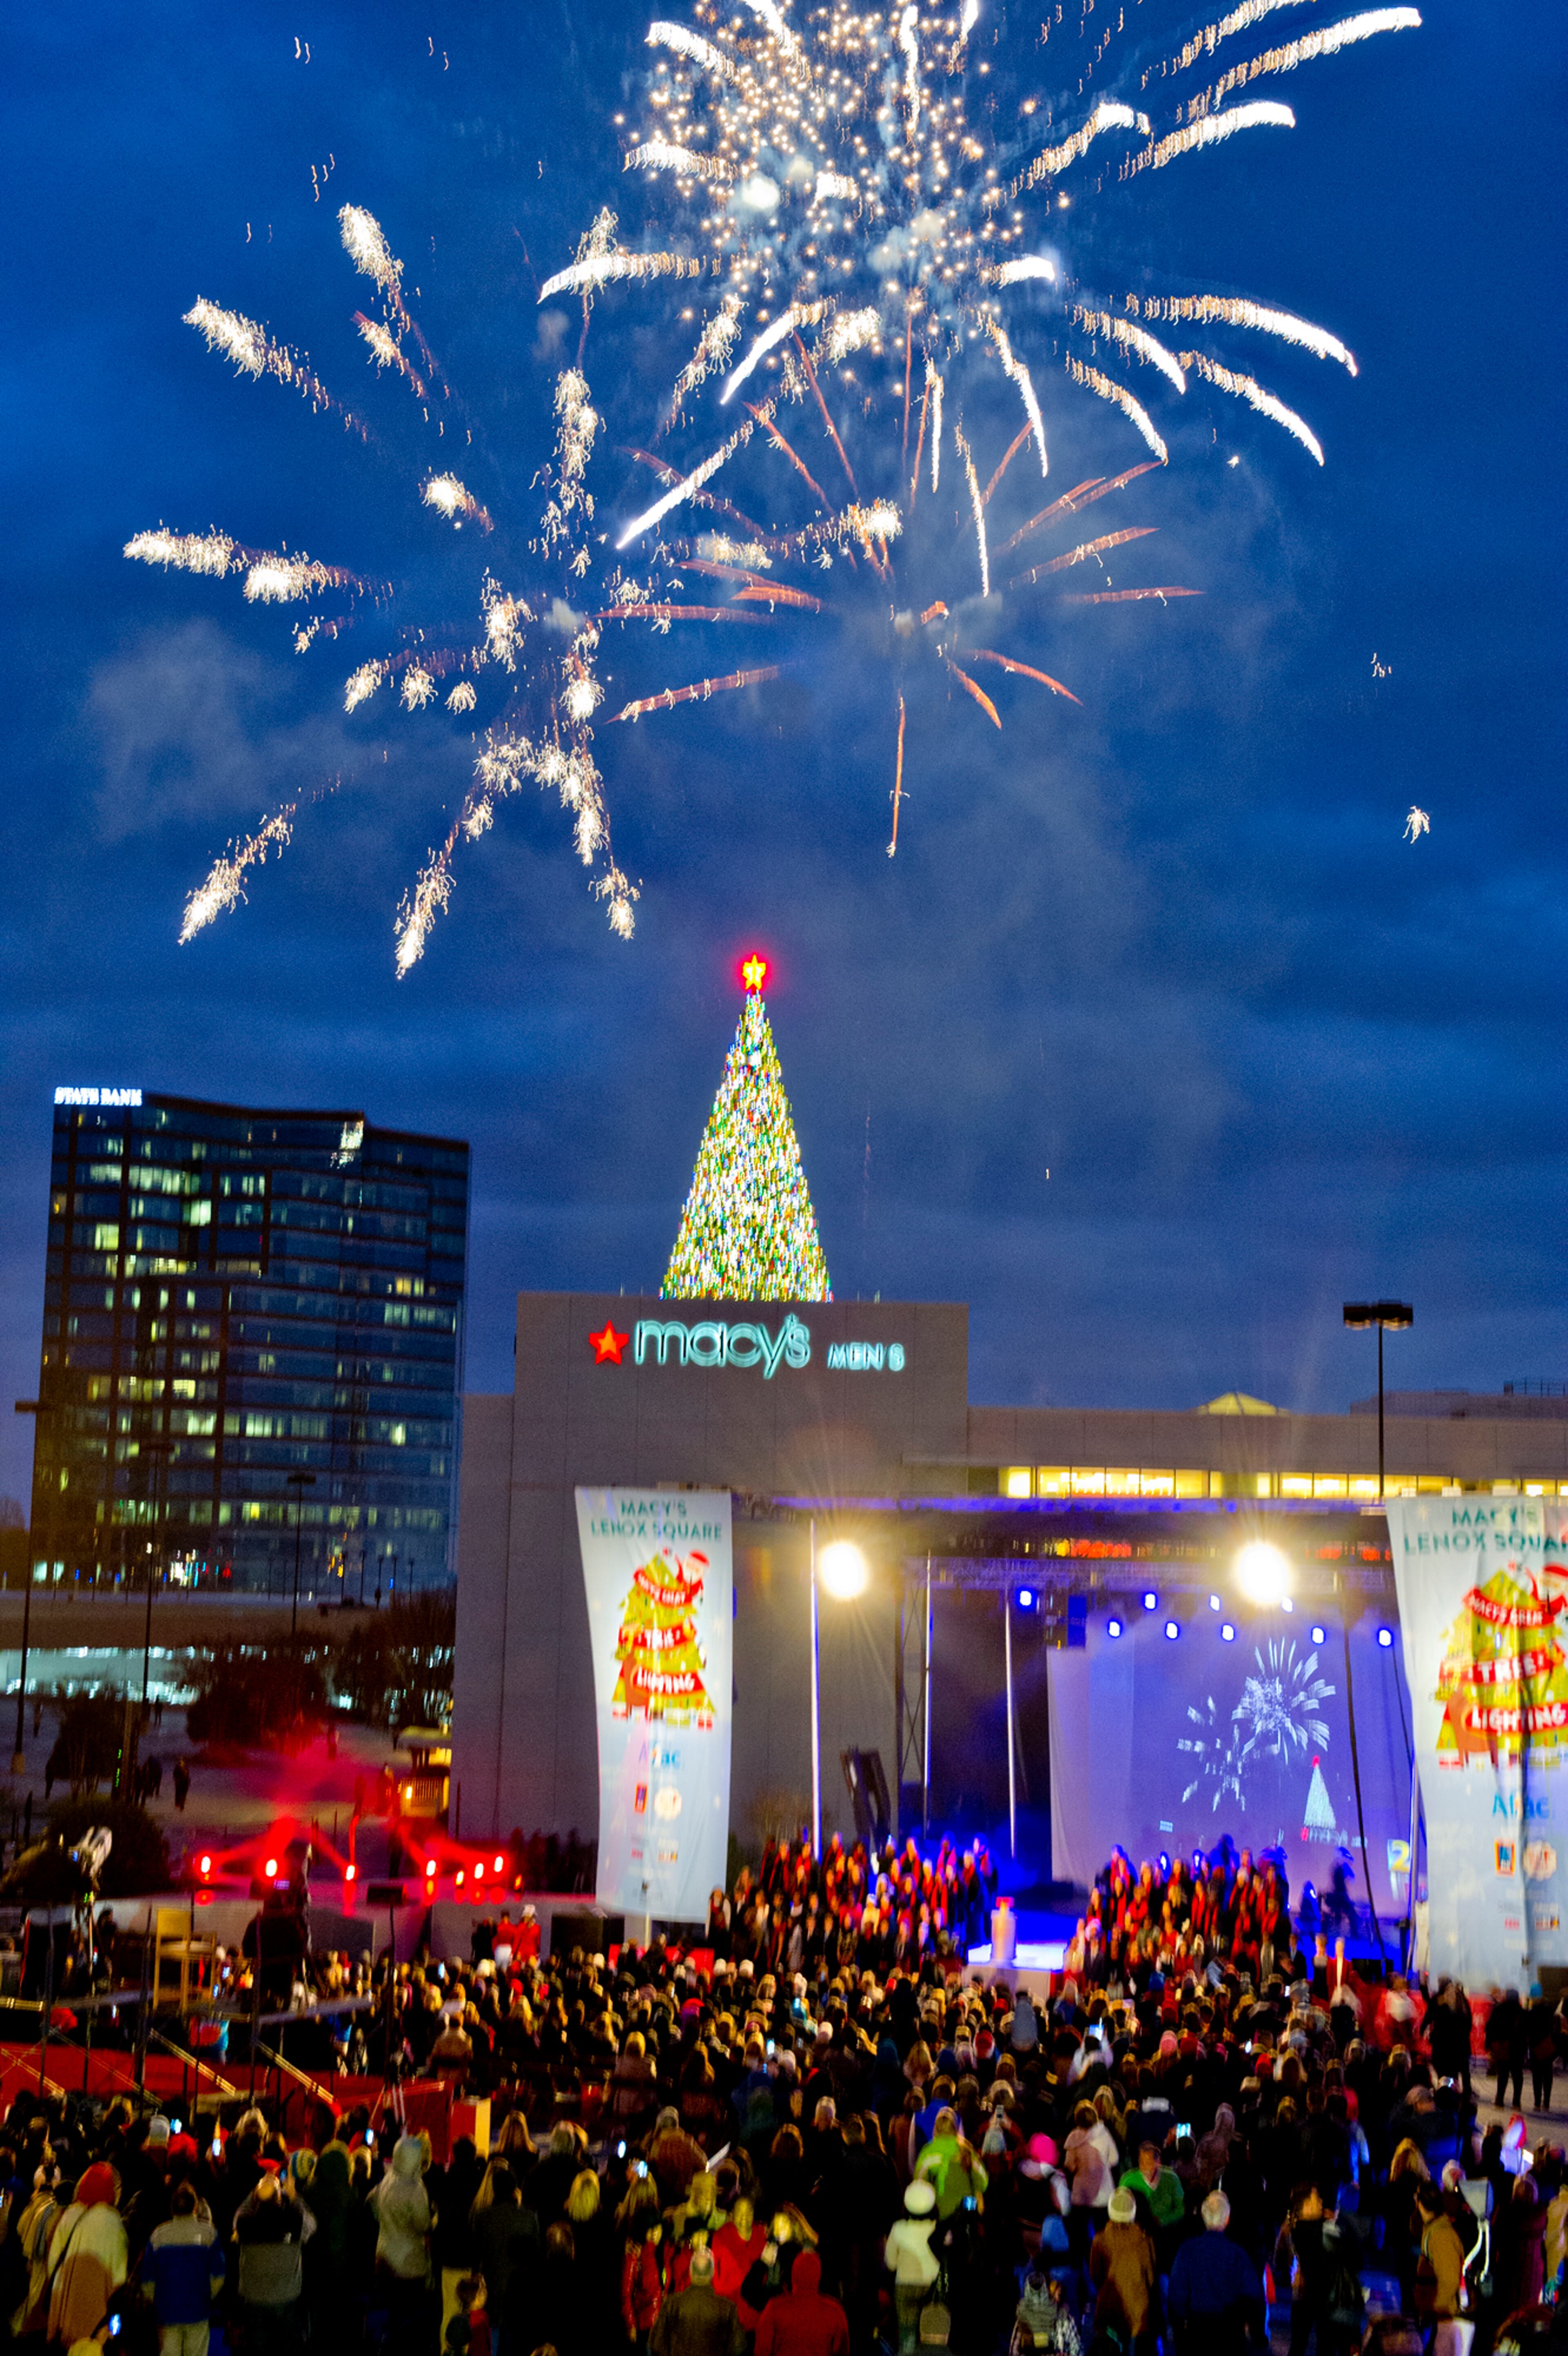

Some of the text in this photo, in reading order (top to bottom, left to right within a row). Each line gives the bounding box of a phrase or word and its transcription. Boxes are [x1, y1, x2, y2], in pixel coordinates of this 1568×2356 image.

[100, 1088, 142, 1106] BANK
[621, 1499, 687, 1518] MACY'S
[1451, 1505, 1538, 1528] MACY'S
[591, 1518, 647, 1538] LENOX
[1404, 1530, 1486, 1554] LENOX
[1477, 1652, 1537, 1683] TREE
[1472, 1702, 1566, 1736] LIGHTING
